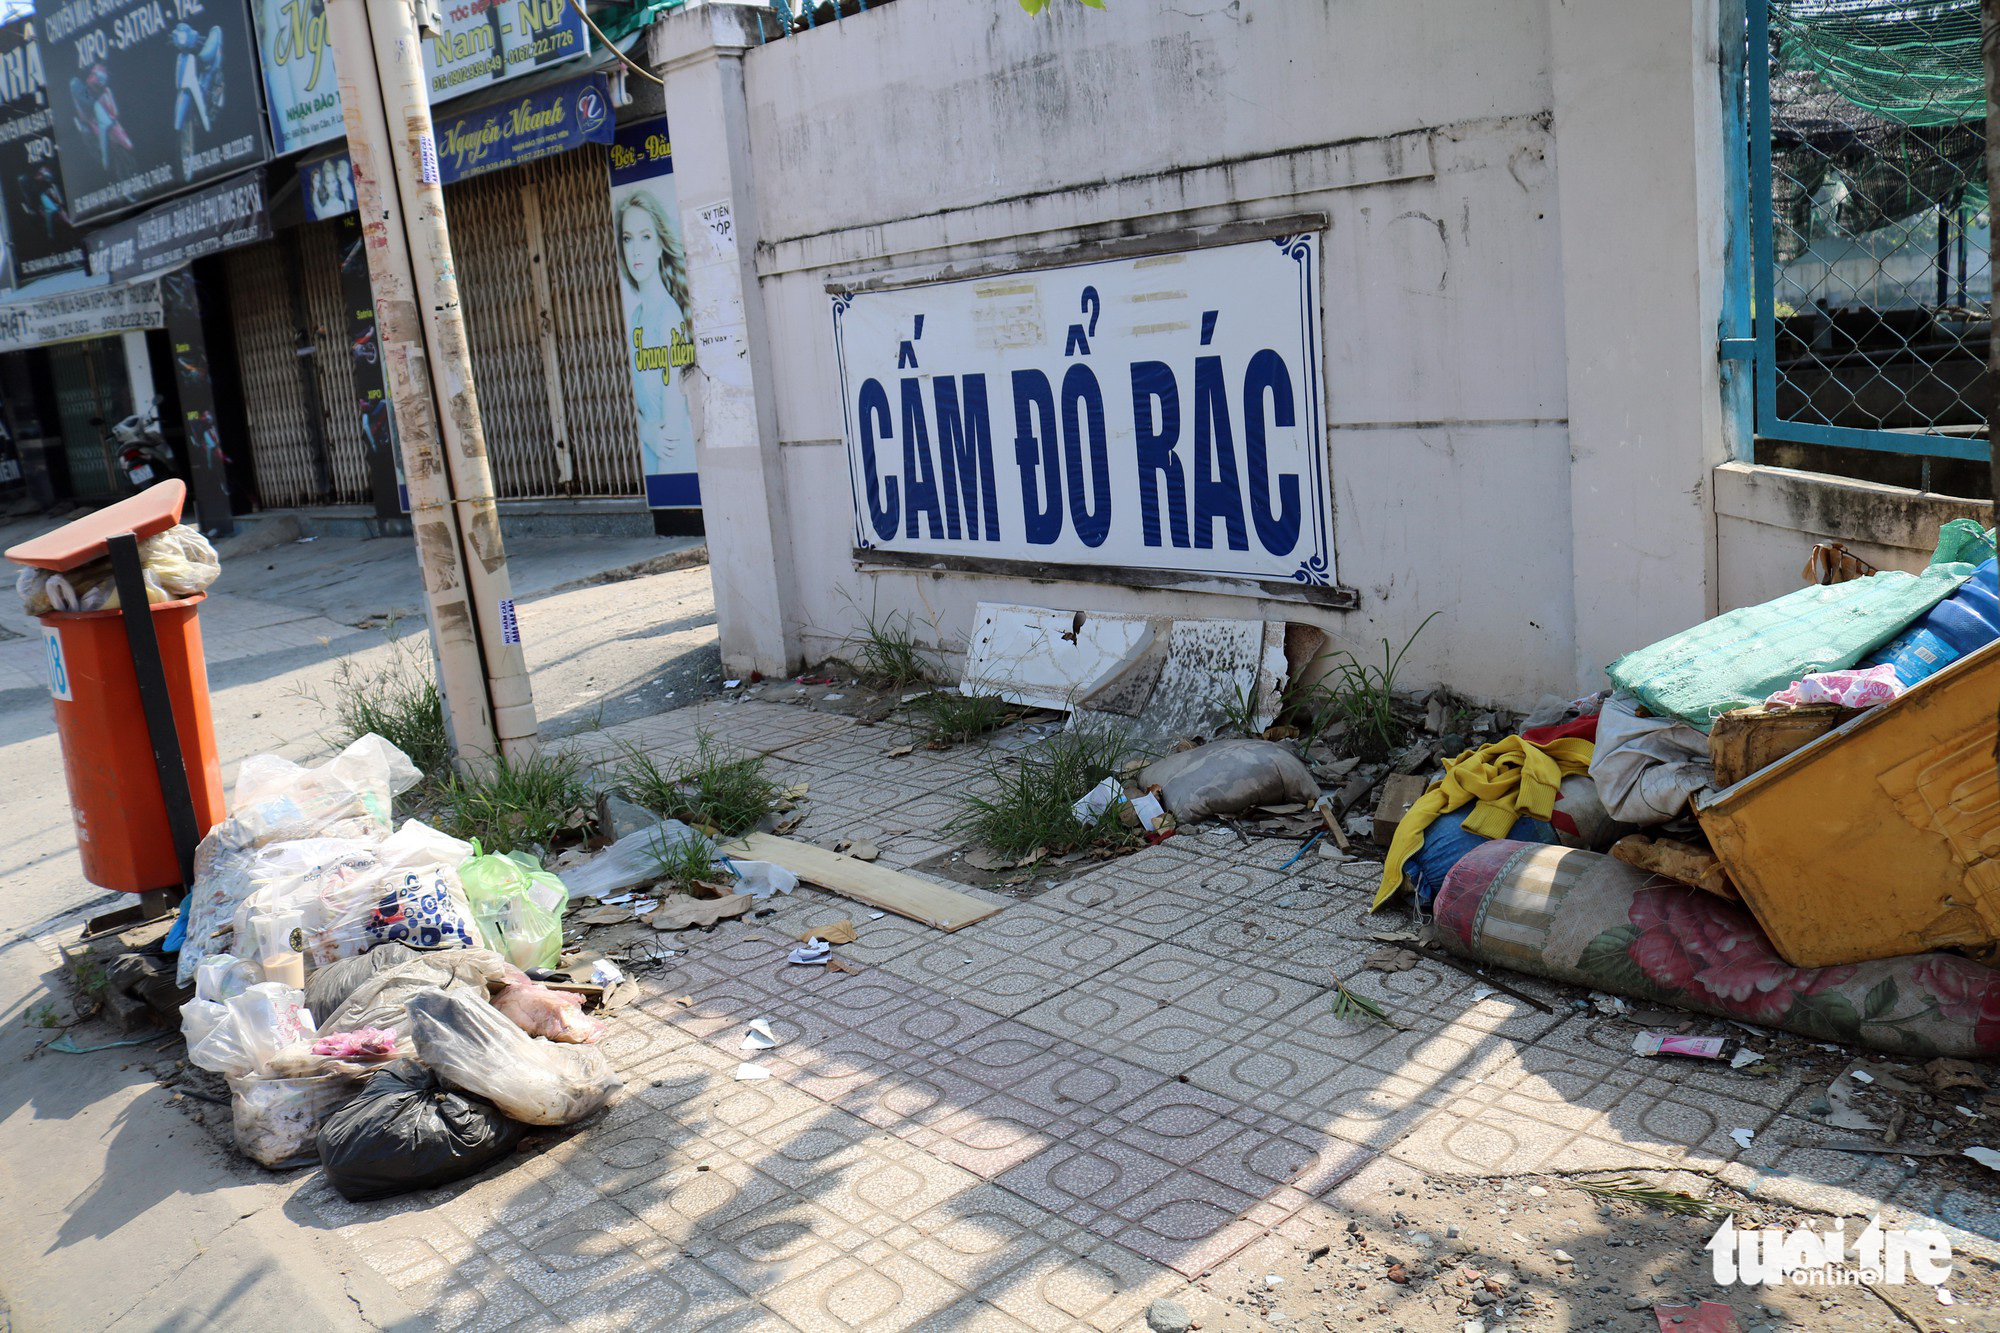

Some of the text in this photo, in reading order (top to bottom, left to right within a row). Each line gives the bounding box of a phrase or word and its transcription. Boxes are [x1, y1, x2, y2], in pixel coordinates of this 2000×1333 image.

[75, 28, 107, 68] XIPO
[114, 0, 165, 49] SATRIA
[433, 23, 494, 68] Nam
[448, 55, 501, 87] 0902.939.649
[508, 29, 574, 65] 0167.222.7726
[314, 92, 335, 113] ĐÀO
[439, 116, 502, 169] Nguyễn
[503, 96, 565, 139] Nhanh
[633, 326, 669, 386] Trang
[858, 285, 1302, 557] CẤM ĐỔ RÁC
